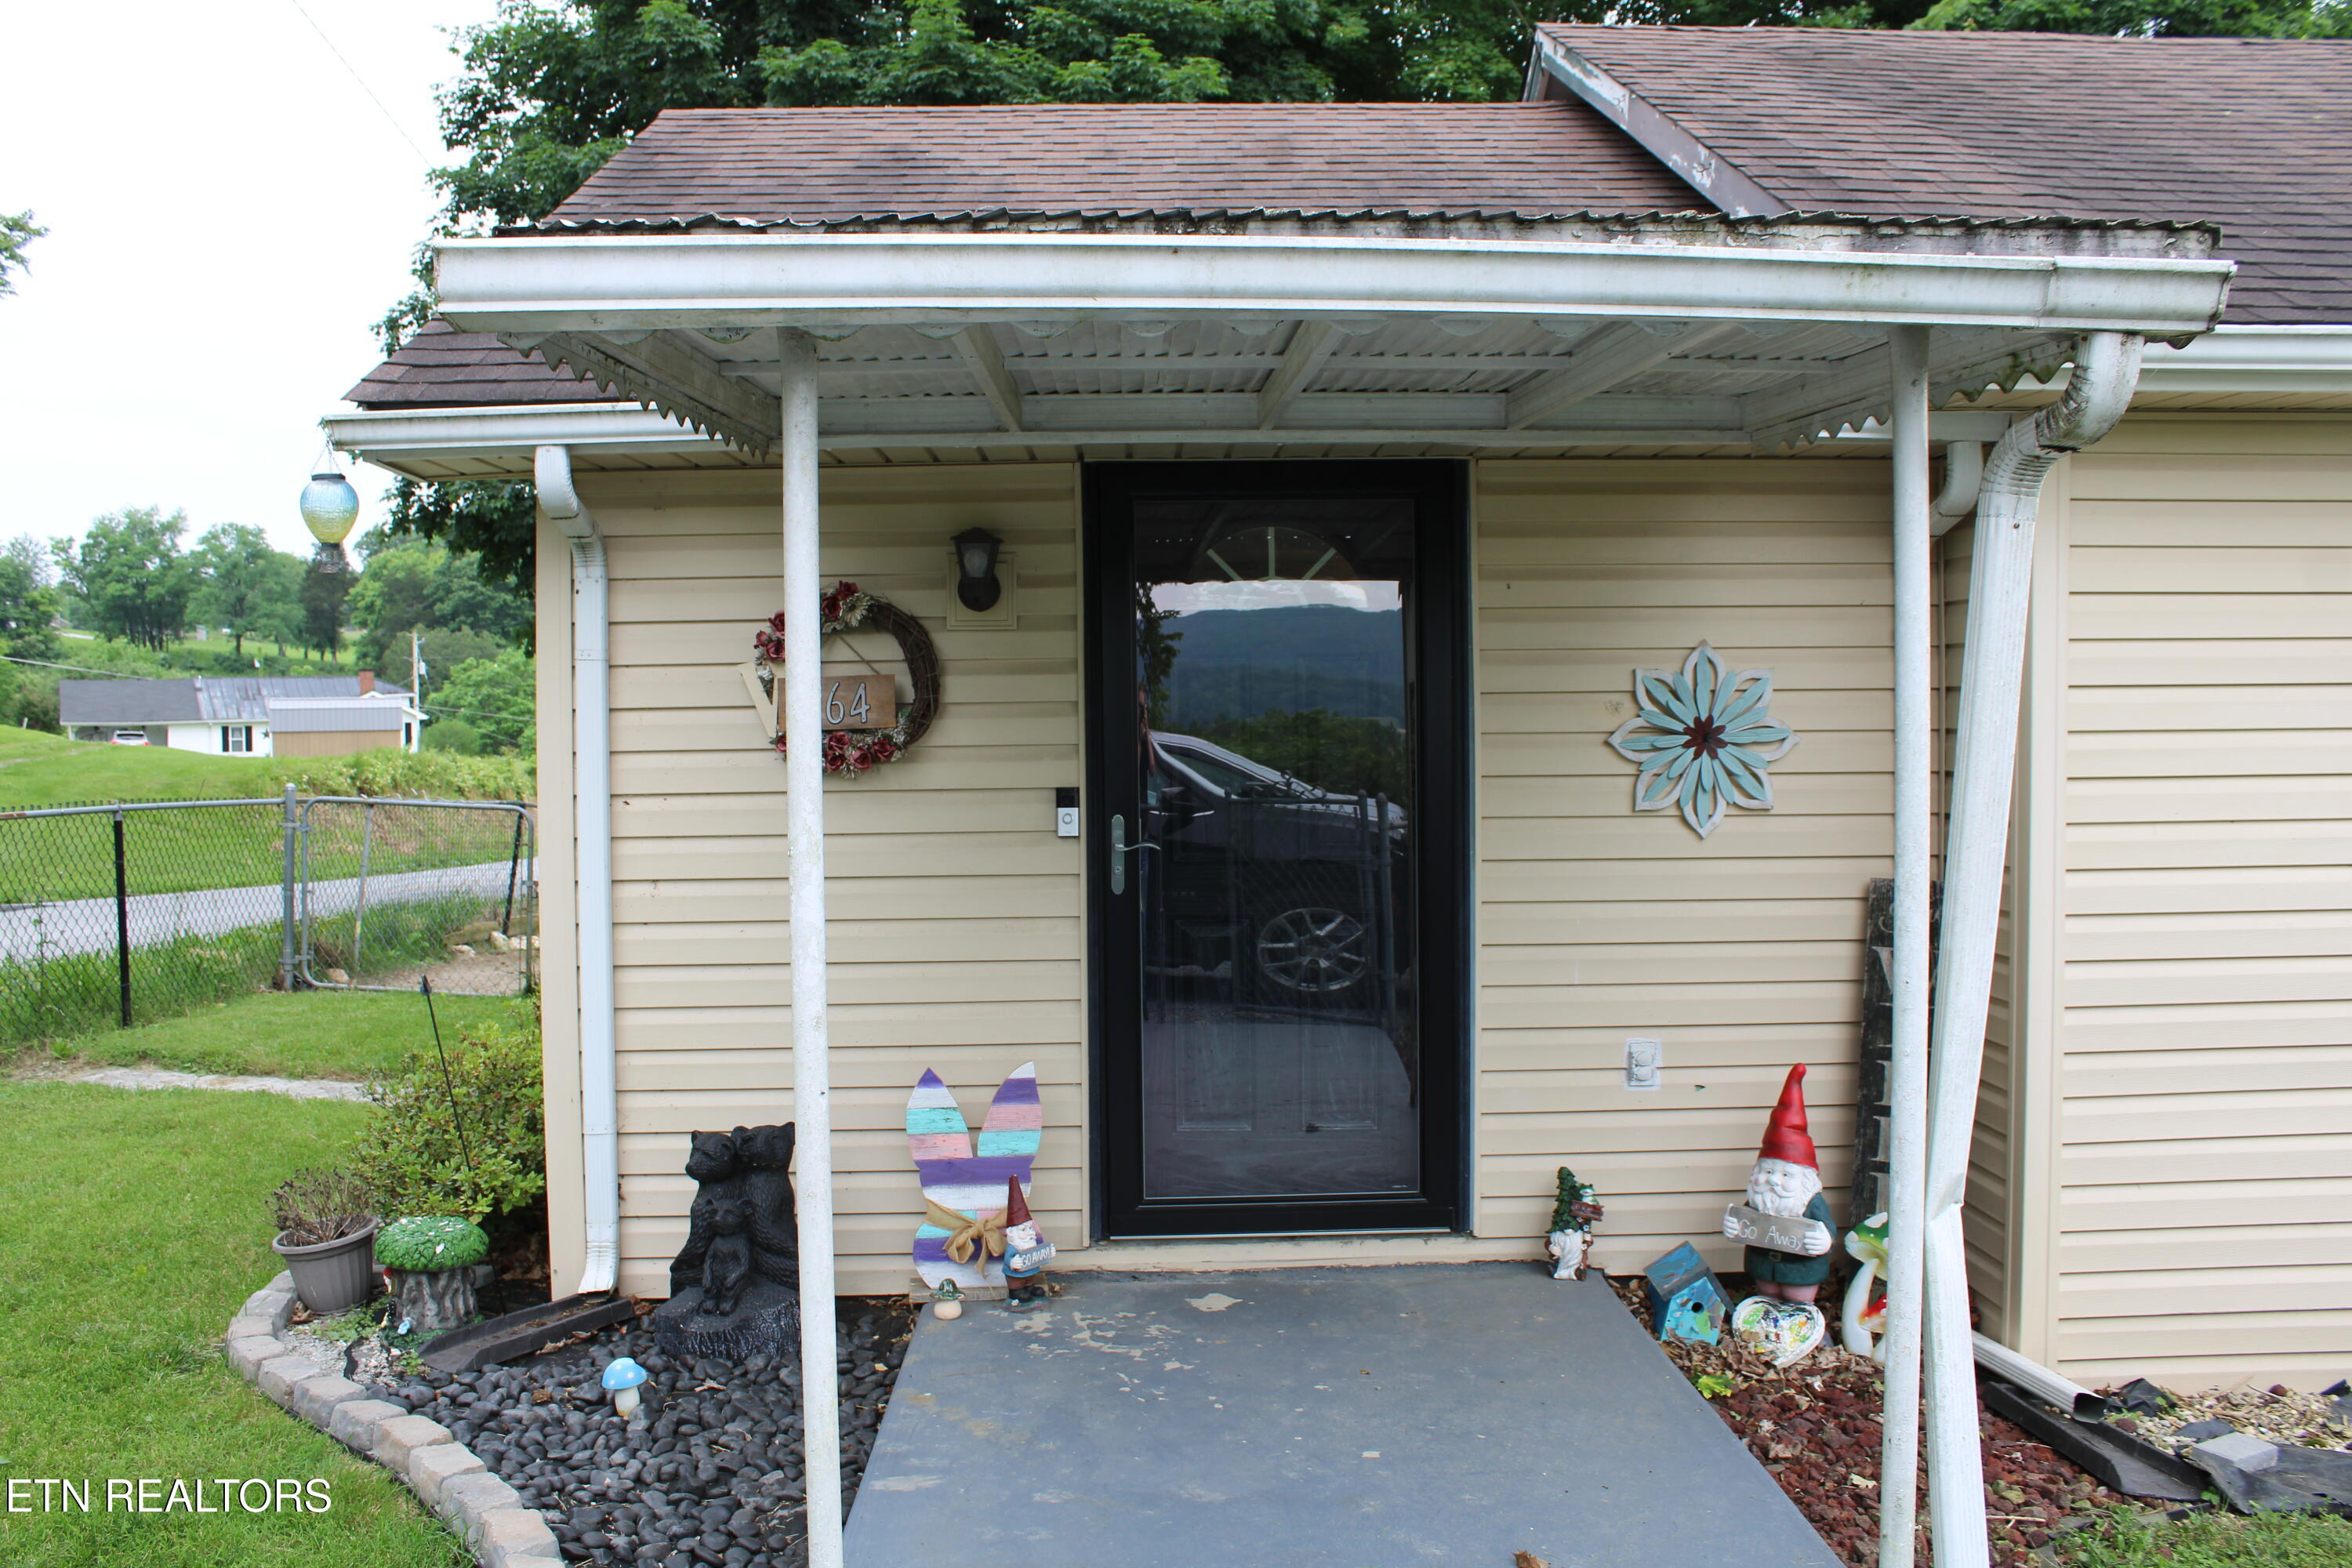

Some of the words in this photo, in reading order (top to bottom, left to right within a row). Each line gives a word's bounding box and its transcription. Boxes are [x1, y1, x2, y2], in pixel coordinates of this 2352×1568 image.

[1738, 1219, 1757, 1239] Go
[1766, 1225, 1803, 1250] Away
[1022, 1254, 1032, 1268] GO
